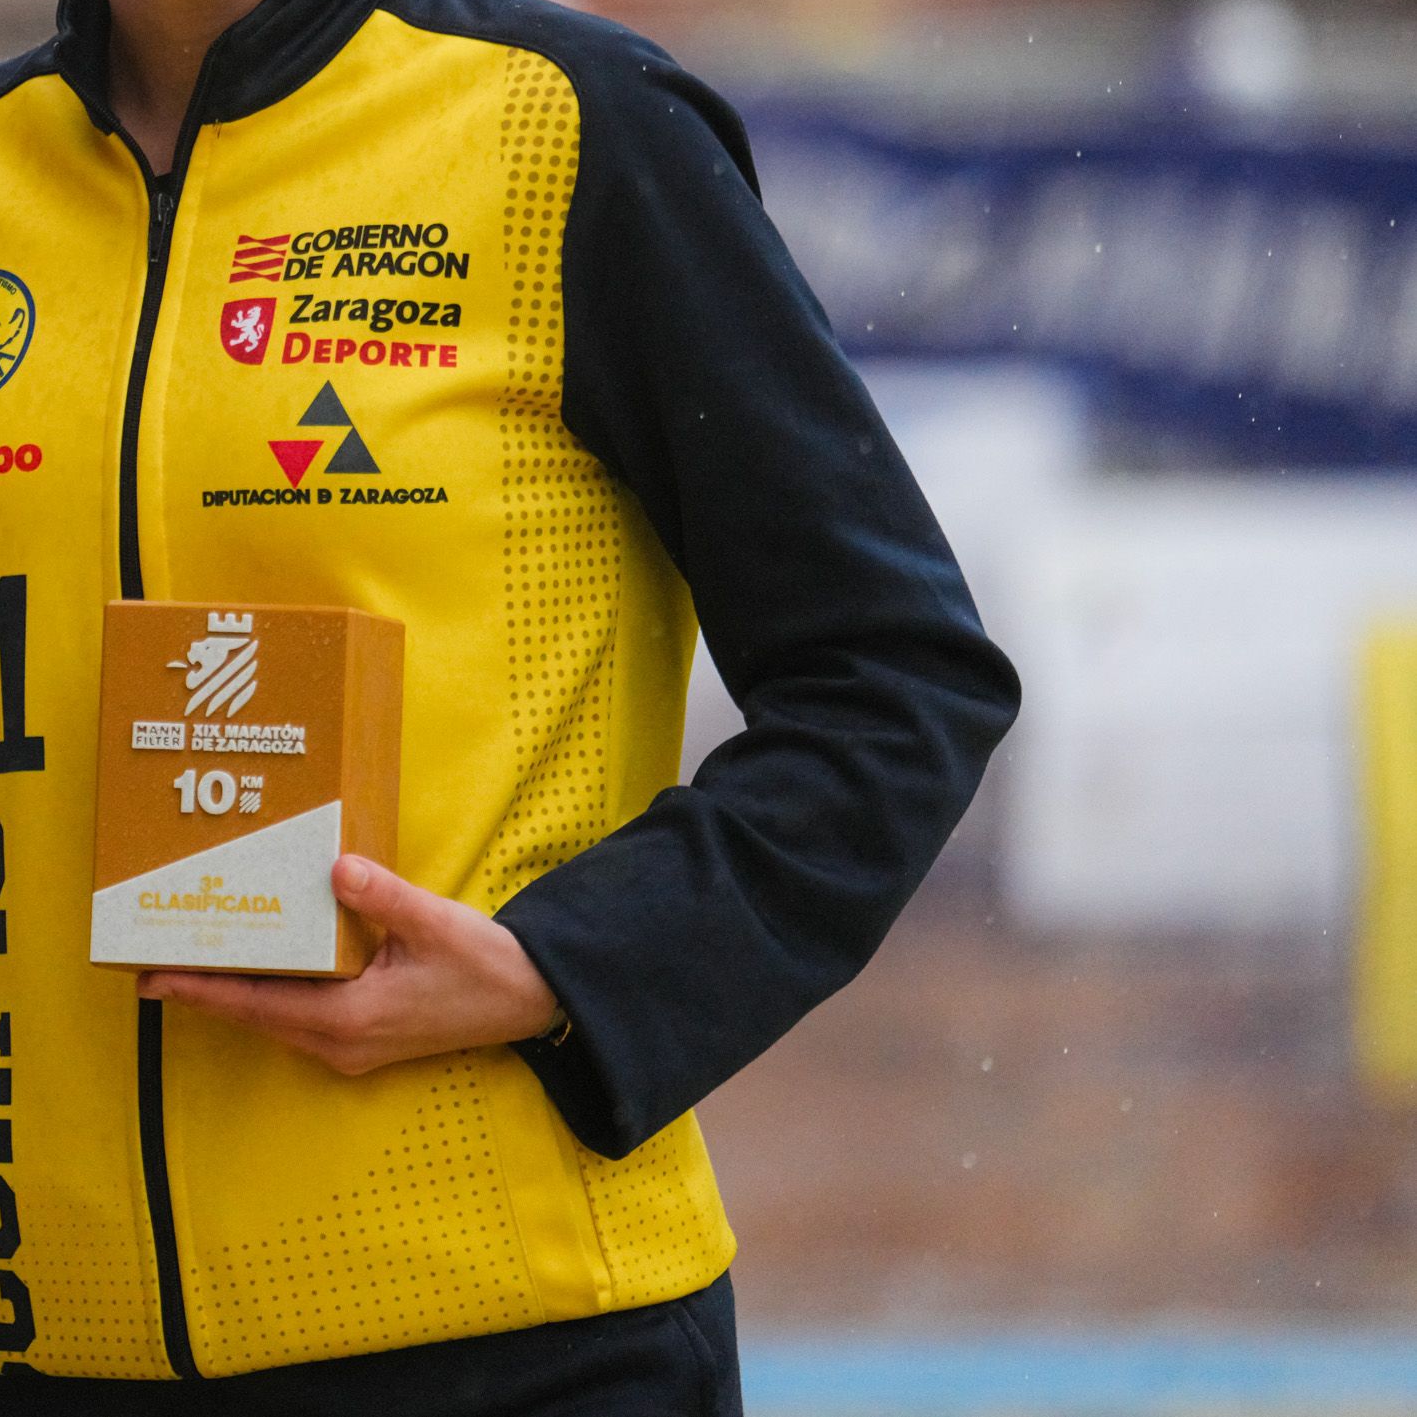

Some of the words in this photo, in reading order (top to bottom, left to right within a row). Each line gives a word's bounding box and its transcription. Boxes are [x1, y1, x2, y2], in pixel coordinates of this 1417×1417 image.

[291, 223, 450, 255] GOBIERNO
[282, 255, 325, 282] DE
[331, 251, 471, 280] ARAGON
[288, 294, 463, 334] Zaragoza
[201, 487, 311, 508] DIPUTACION
[339, 487, 449, 505] ZARAGOZA
[136, 724, 181, 735] MANN
[192, 723, 221, 738] XIX
[224, 724, 306, 741] MARATÓN
[135, 735, 181, 747] FILTER
[191, 738, 214, 752] DE
[215, 739, 307, 754] ZARAGOZA
[173, 769, 237, 816] 10
[240, 775, 264, 789] KM
[138, 891, 283, 915] CLASIFICADA
